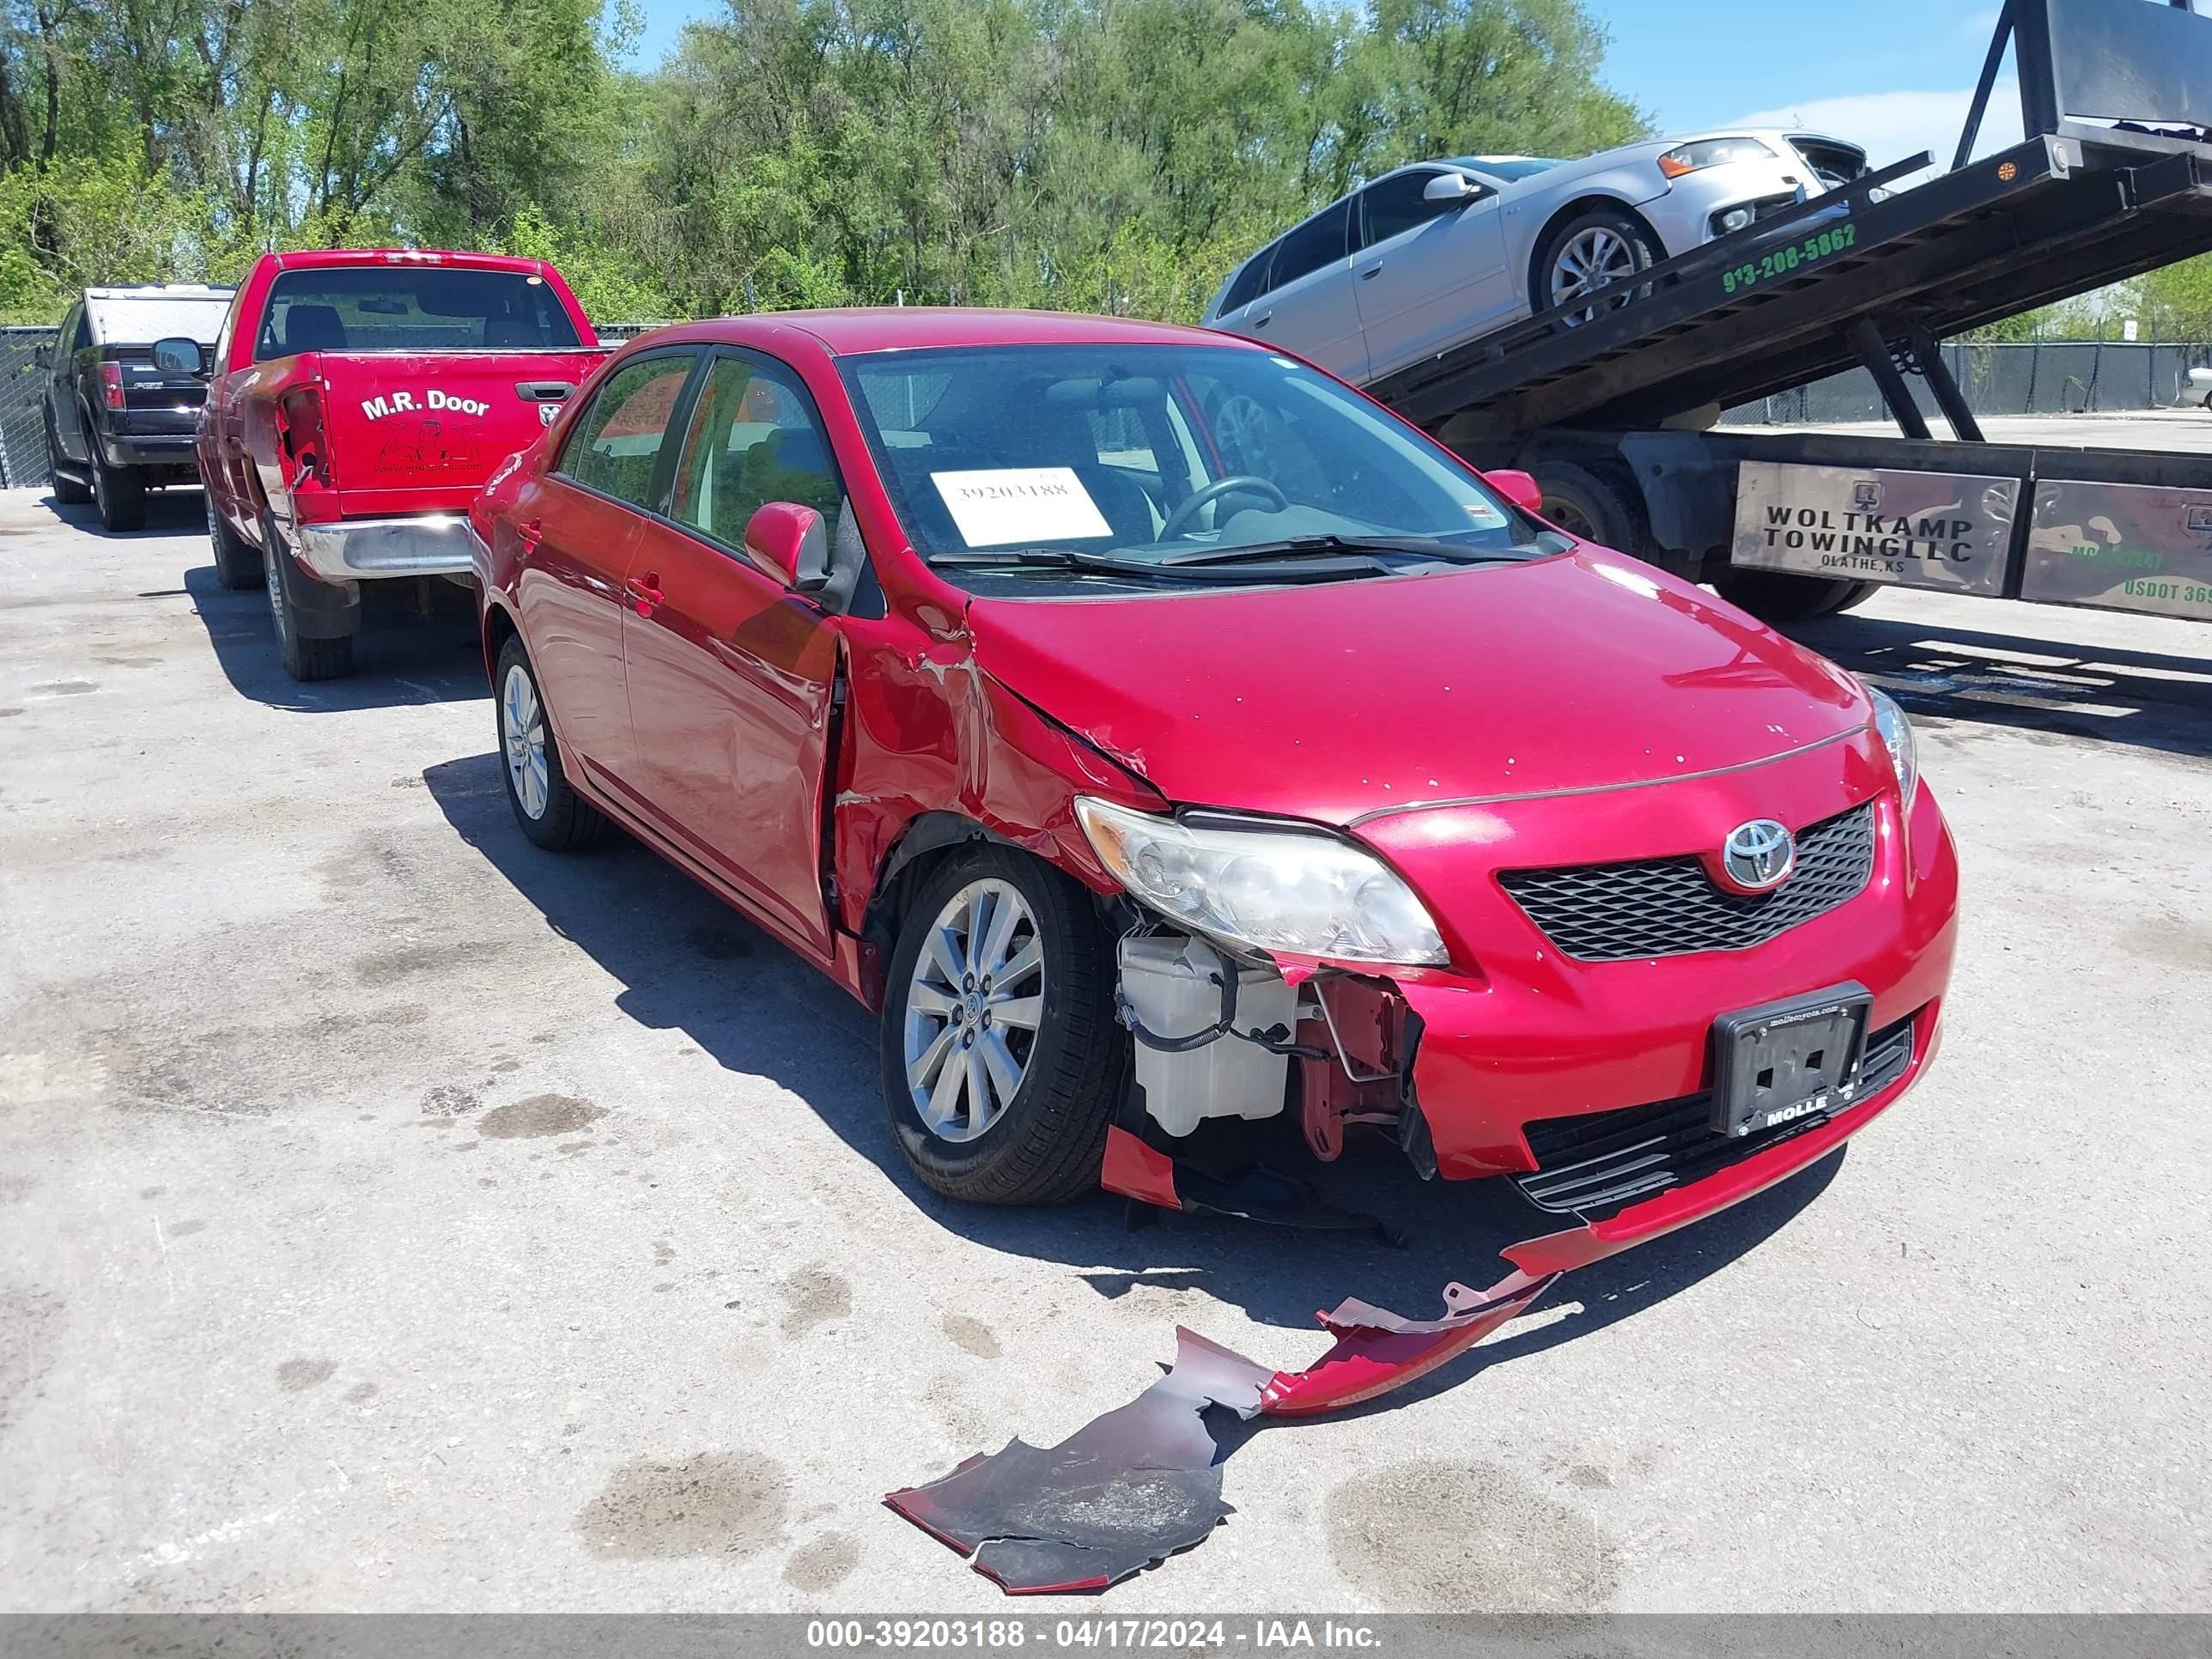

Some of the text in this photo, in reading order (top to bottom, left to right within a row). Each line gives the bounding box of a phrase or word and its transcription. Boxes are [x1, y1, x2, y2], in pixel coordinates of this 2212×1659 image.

[1723, 223, 1856, 293] 913-208-5862
[361, 389, 490, 421] M.R. Door
[958, 484, 1067, 500] 39203188
[1766, 506, 1972, 539] WOLTKAMP
[2124, 580, 2179, 599] USDOT
[1770, 1006, 1838, 1026] molletoyota.com
[1767, 1096, 1827, 1126] MOLLE
